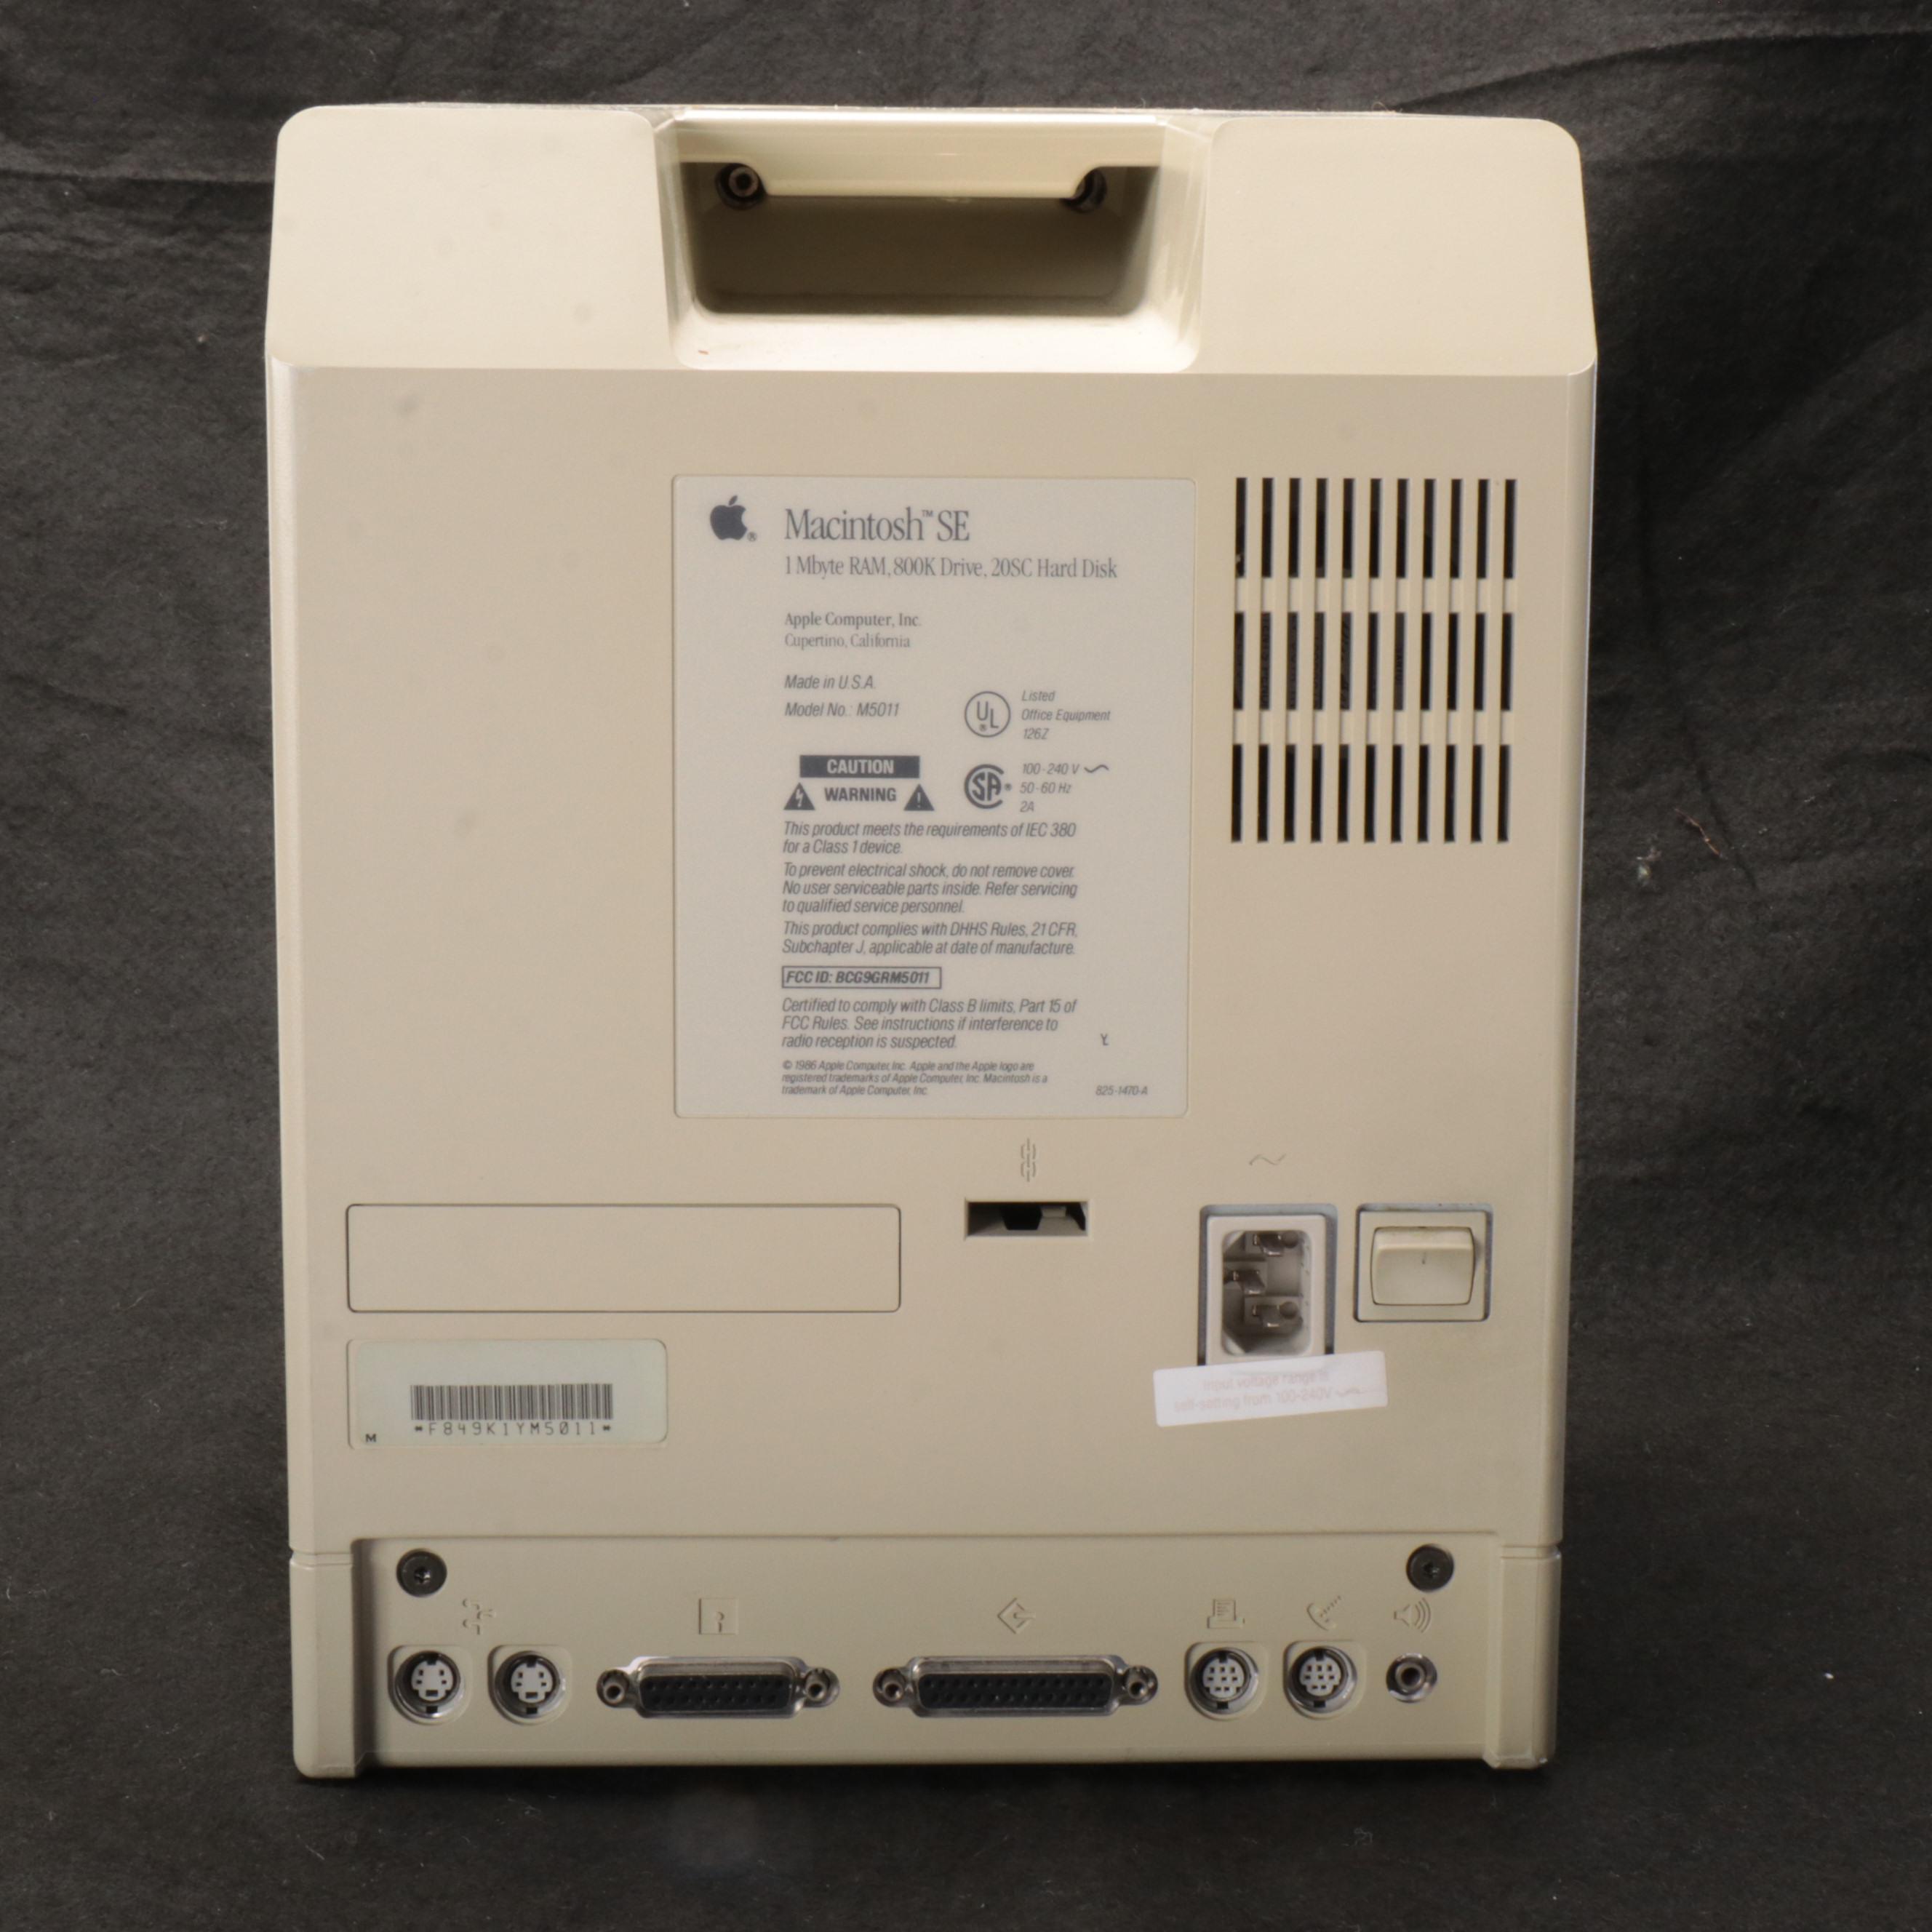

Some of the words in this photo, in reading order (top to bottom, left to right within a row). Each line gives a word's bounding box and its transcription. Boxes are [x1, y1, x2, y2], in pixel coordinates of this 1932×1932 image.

[937, 511, 970, 541] SE
[786, 556, 791, 574] 1
[797, 554, 844, 579] Mbyte
[941, 557, 987, 577] Drive,
[991, 558, 1032, 577] 20SC
[1037, 558, 1077, 578] Hard
[1082, 558, 1117, 578] Disk
[785, 611, 822, 629] Apple
[825, 612, 895, 630] Computer,
[898, 613, 921, 626] Inc.
[785, 634, 847, 650] Cupertino,
[850, 633, 910, 647] California
[784, 675, 820, 689] Made
[823, 677, 835, 689] in
[838, 675, 875, 690] U.S.A.
[1021, 690, 1055, 701] Listed
[785, 703, 824, 716] Model
[826, 703, 853, 716] No.:
[856, 702, 900, 716] M5011
[1021, 708, 1053, 721] Office
[1055, 709, 1111, 722] Equipment
[1024, 727, 1050, 740] 126Z
[828, 759, 894, 775] CAUTION
[1072, 764, 1080, 774] V
[824, 788, 896, 802] WARNING
[1058, 783, 1072, 794] Hz
[1020, 801, 1034, 813] 2A
[785, 821, 810, 836] This
[812, 822, 860, 838] product
[862, 823, 901, 837] meets
[903, 822, 925, 837] the
[926, 823, 1008, 838] requirements
[1010, 823, 1024, 837] of
[1025, 822, 1047, 837] IEC
[1050, 823, 1077, 837] 380
[783, 839, 800, 853] for
[802, 842, 810, 853] a
[813, 839, 849, 853] Class
[853, 840, 860, 853] 1
[859, 840, 902, 854] device.
[784, 862, 797, 877] To
[799, 864, 846, 879] prevent
[847, 863, 907, 877] electrical
[909, 863, 949, 878] shock,
[951, 863, 967, 877] do
[969, 865, 990, 877] not
[991, 866, 1038, 878] remove
[1039, 866, 1075, 878] cover.
[783, 880, 802, 894] No
[803, 883, 831, 895] user
[833, 882, 905, 895] serviceable
[906, 882, 940, 897] parts
[941, 882, 981, 895] inside.
[984, 882, 1019, 895] Refer
[1021, 882, 1078, 898] servicing
[782, 900, 795, 912] to
[797, 898, 852, 914] qualified
[853, 899, 899, 913] service
[900, 900, 964, 915] personnel.
[784, 921, 810, 935] This
[811, 922, 859, 937] product
[861, 922, 919, 938] complies
[921, 922, 948, 935] with
[949, 922, 988, 936] DHHS
[990, 922, 1029, 937] Rules,
[782, 938, 854, 956] Subchapter
[869, 940, 933, 956] applicable
[935, 941, 949, 954] at
[951, 941, 978, 954] date
[980, 940, 994, 954] of
[995, 941, 1074, 954] manufacture.
[786, 970, 815, 983] FCC
[815, 971, 833, 983] ID:
[835, 971, 930, 983] BCG9GRM5011
[782, 997, 836, 1012] Certified
[838, 999, 851, 1012] to
[853, 999, 898, 1015] comply
[900, 999, 927, 1012] with
[928, 998, 965, 1013] Class
[967, 999, 977, 1013] B
[979, 999, 1015, 1013] limits,
[1018, 999, 1045, 1013] Part
[1049, 999, 1061, 1013] 15
[1063, 999, 1078, 1013] of
[782, 1015, 810, 1030] FCC
[812, 1015, 850, 1030] Rules.
[854, 1015, 879, 1030] See
[881, 1017, 955, 1031] instructions
[957, 1017, 967, 1030] if
[968, 1016, 1044, 1031] interference
[1045, 1018, 1058, 1031] to
[781, 1034, 813, 1047] radio
[815, 1035, 874, 1050] reception
[876, 1034, 887, 1048] is
[890, 1035, 957, 1050] suspected.
[795, 1060, 817, 1070] 1986
[818, 1061, 845, 1074] Apple
[909, 1061, 936, 1074] Apple
[938, 1062, 955, 1071] and
[955, 1061, 970, 1071] the
[971, 1061, 998, 1072] Apple
[999, 1061, 1018, 1073] logo
[1018, 1063, 1034, 1071] are
[782, 1073, 828, 1084] registered
[829, 1074, 879, 1082] trademarks
[881, 1074, 891, 1083] of
[892, 1073, 918, 1084] Apple
[983, 1073, 1030, 1083] Macintosh
[1031, 1075, 1040, 1083] is
[1041, 1075, 1047, 1083] a
[782, 1085, 826, 1094] trademark
[829, 1085, 839, 1095] of
[839, 1085, 866, 1095] Apple
